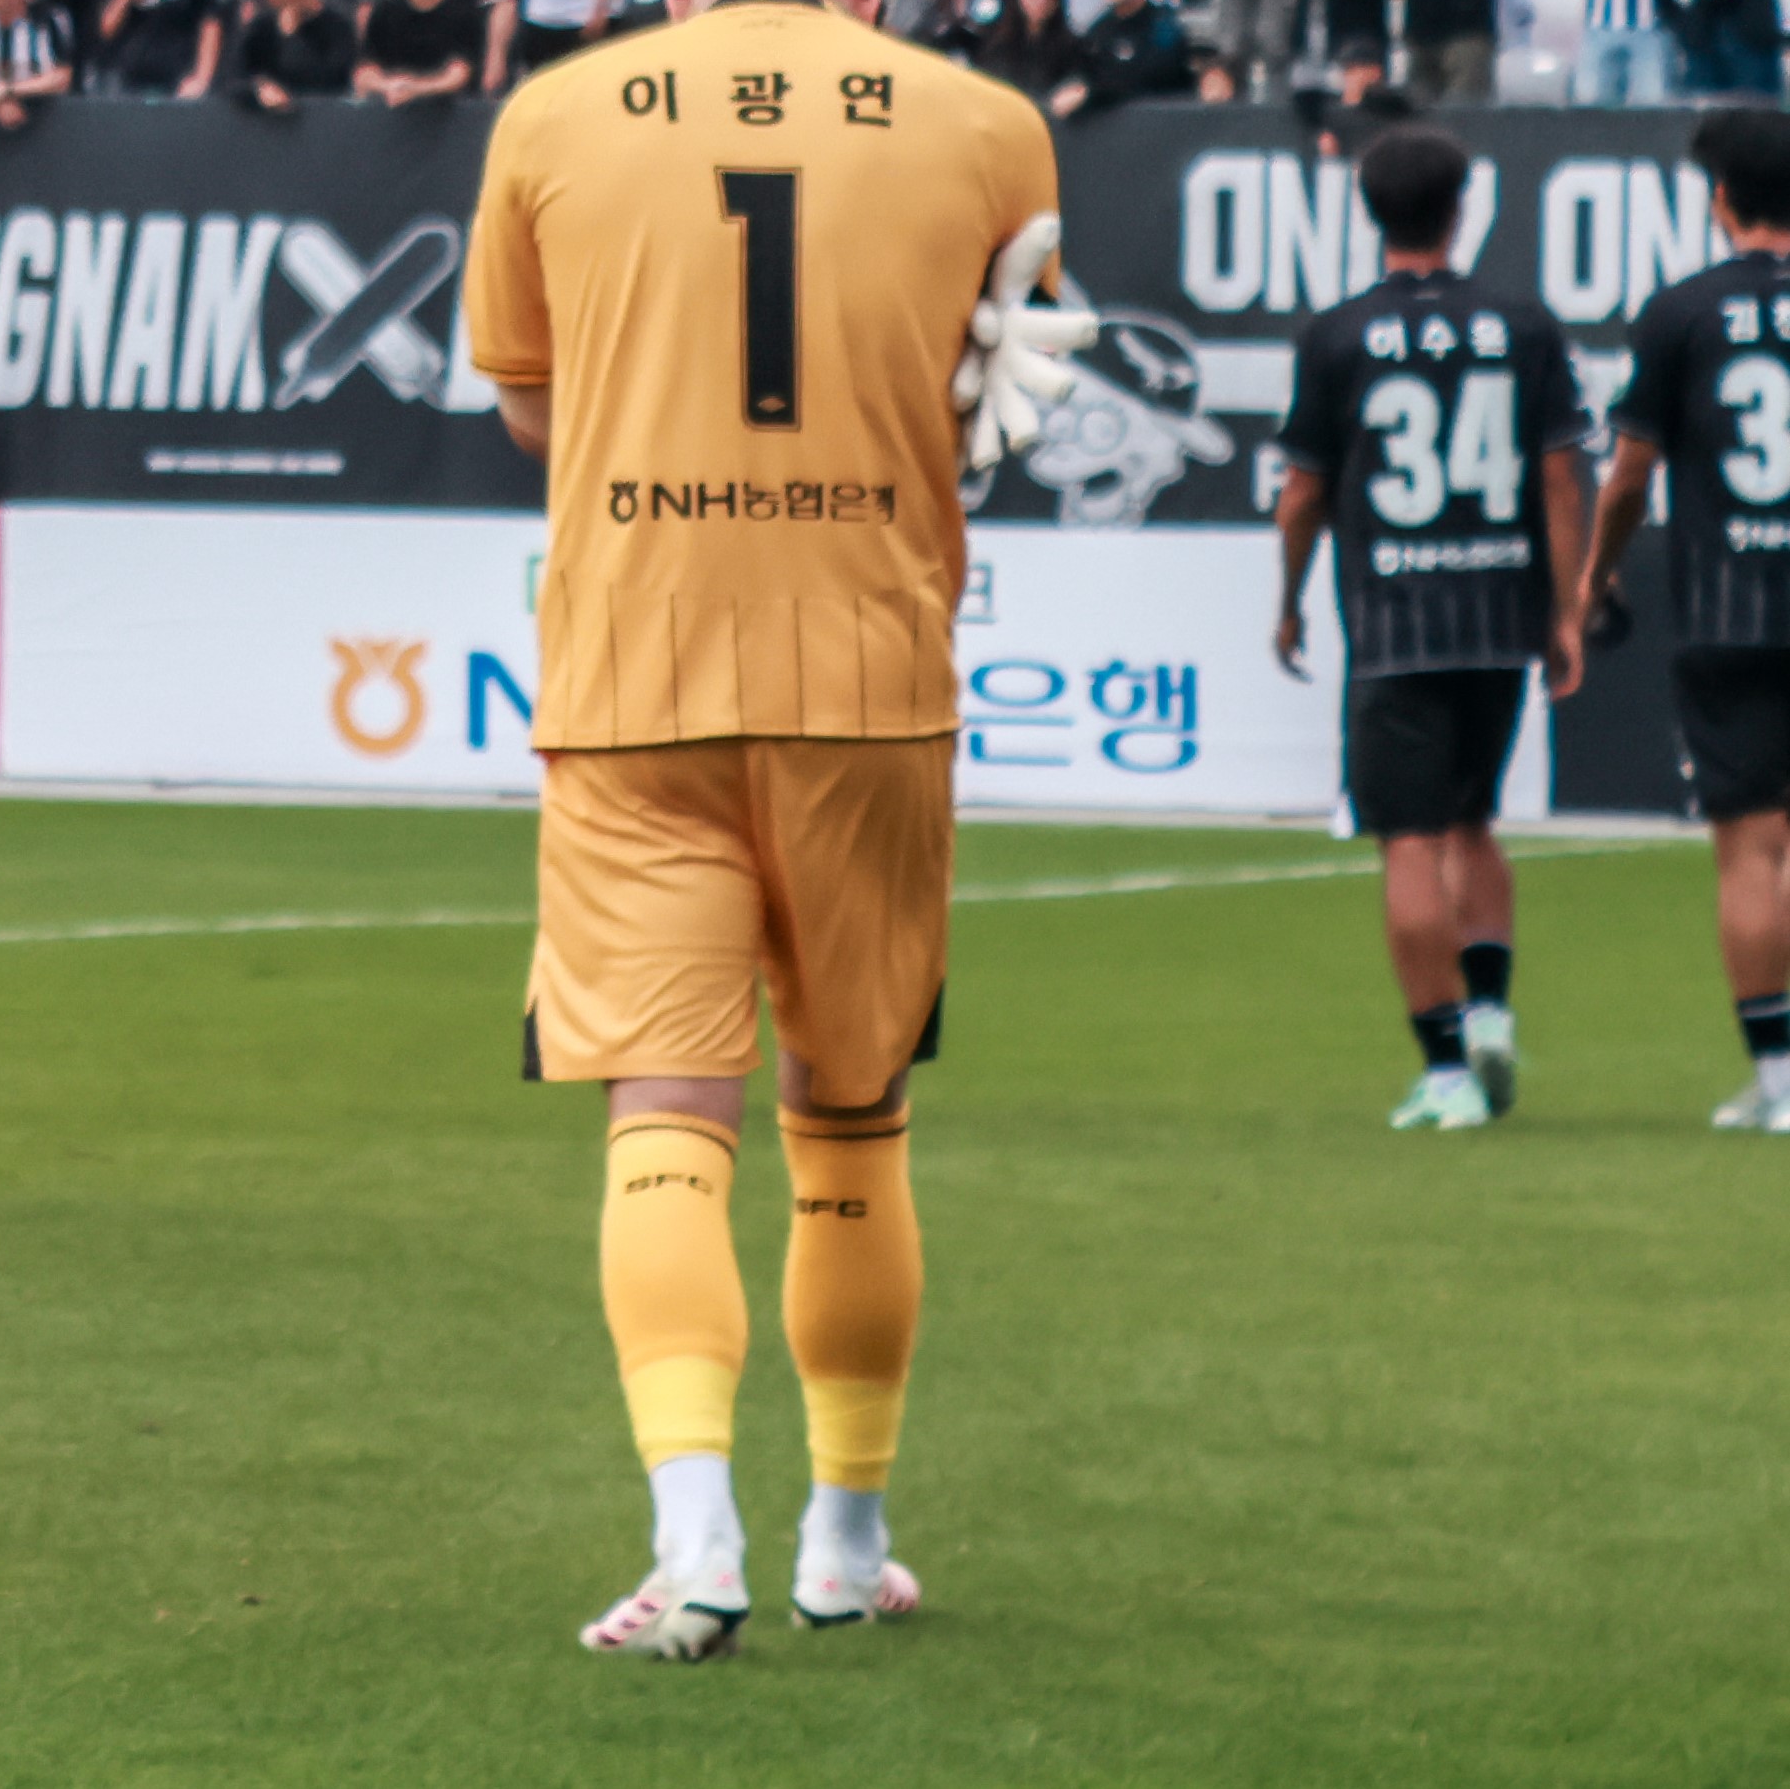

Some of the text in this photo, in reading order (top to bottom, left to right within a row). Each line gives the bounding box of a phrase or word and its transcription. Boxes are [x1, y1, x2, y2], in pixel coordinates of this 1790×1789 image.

[715, 166, 801, 432] 1
[1183, 150, 1498, 312] ON
[1363, 370, 1524, 526] 34
